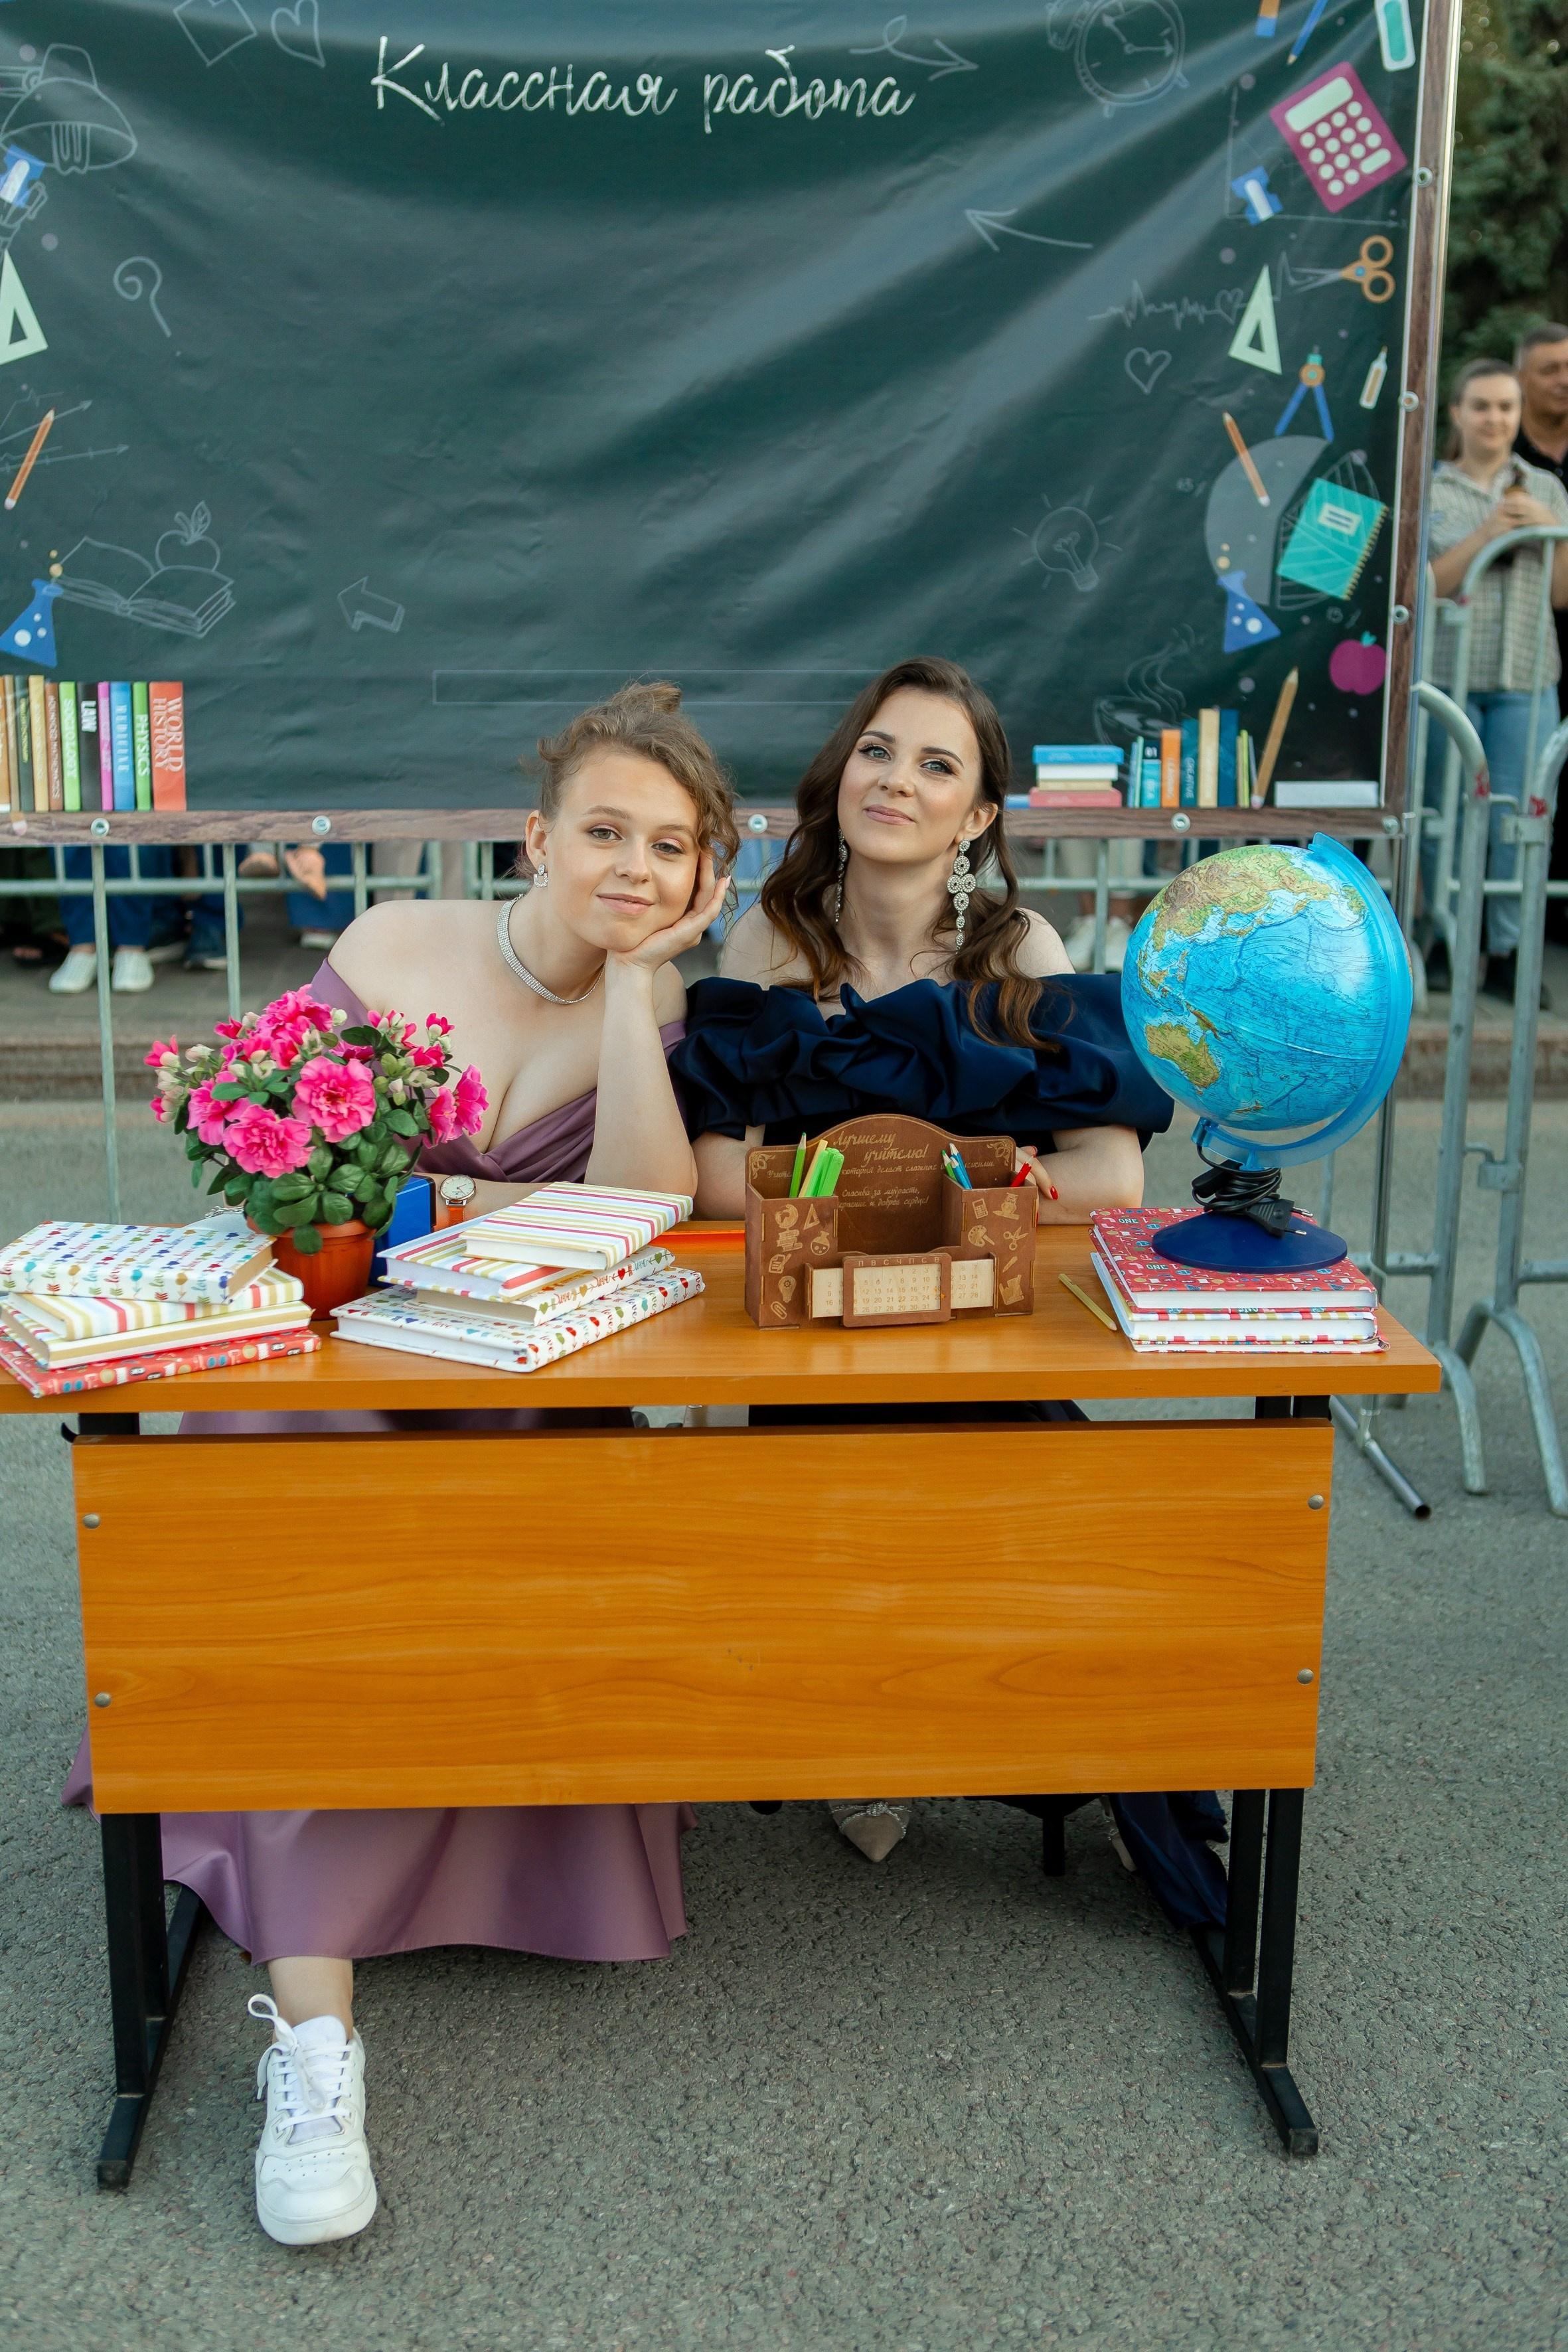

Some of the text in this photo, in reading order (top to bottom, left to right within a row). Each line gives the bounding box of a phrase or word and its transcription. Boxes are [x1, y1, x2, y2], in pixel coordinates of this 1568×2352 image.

[370, 35, 917, 134] Классная работа
[81, 700, 97, 732] LAW
[153, 698, 169, 771] HISTORY
[167, 696, 184, 772] WORLD
[135, 714, 151, 777] PHYSICS
[833, 1131, 896, 1152] Лучшему
[861, 1143, 930, 1168] учителю!
[842, 1186, 920, 1198] Спасибо за мудрость,
[878, 1196, 900, 1209] доброе
[903, 1196, 929, 1208] сердце!
[667, 1280, 679, 1300] love
[690, 1271, 701, 1292] love
[625, 1298, 638, 1320] love
[647, 1290, 658, 1311] love
[601, 1308, 613, 1330] love
